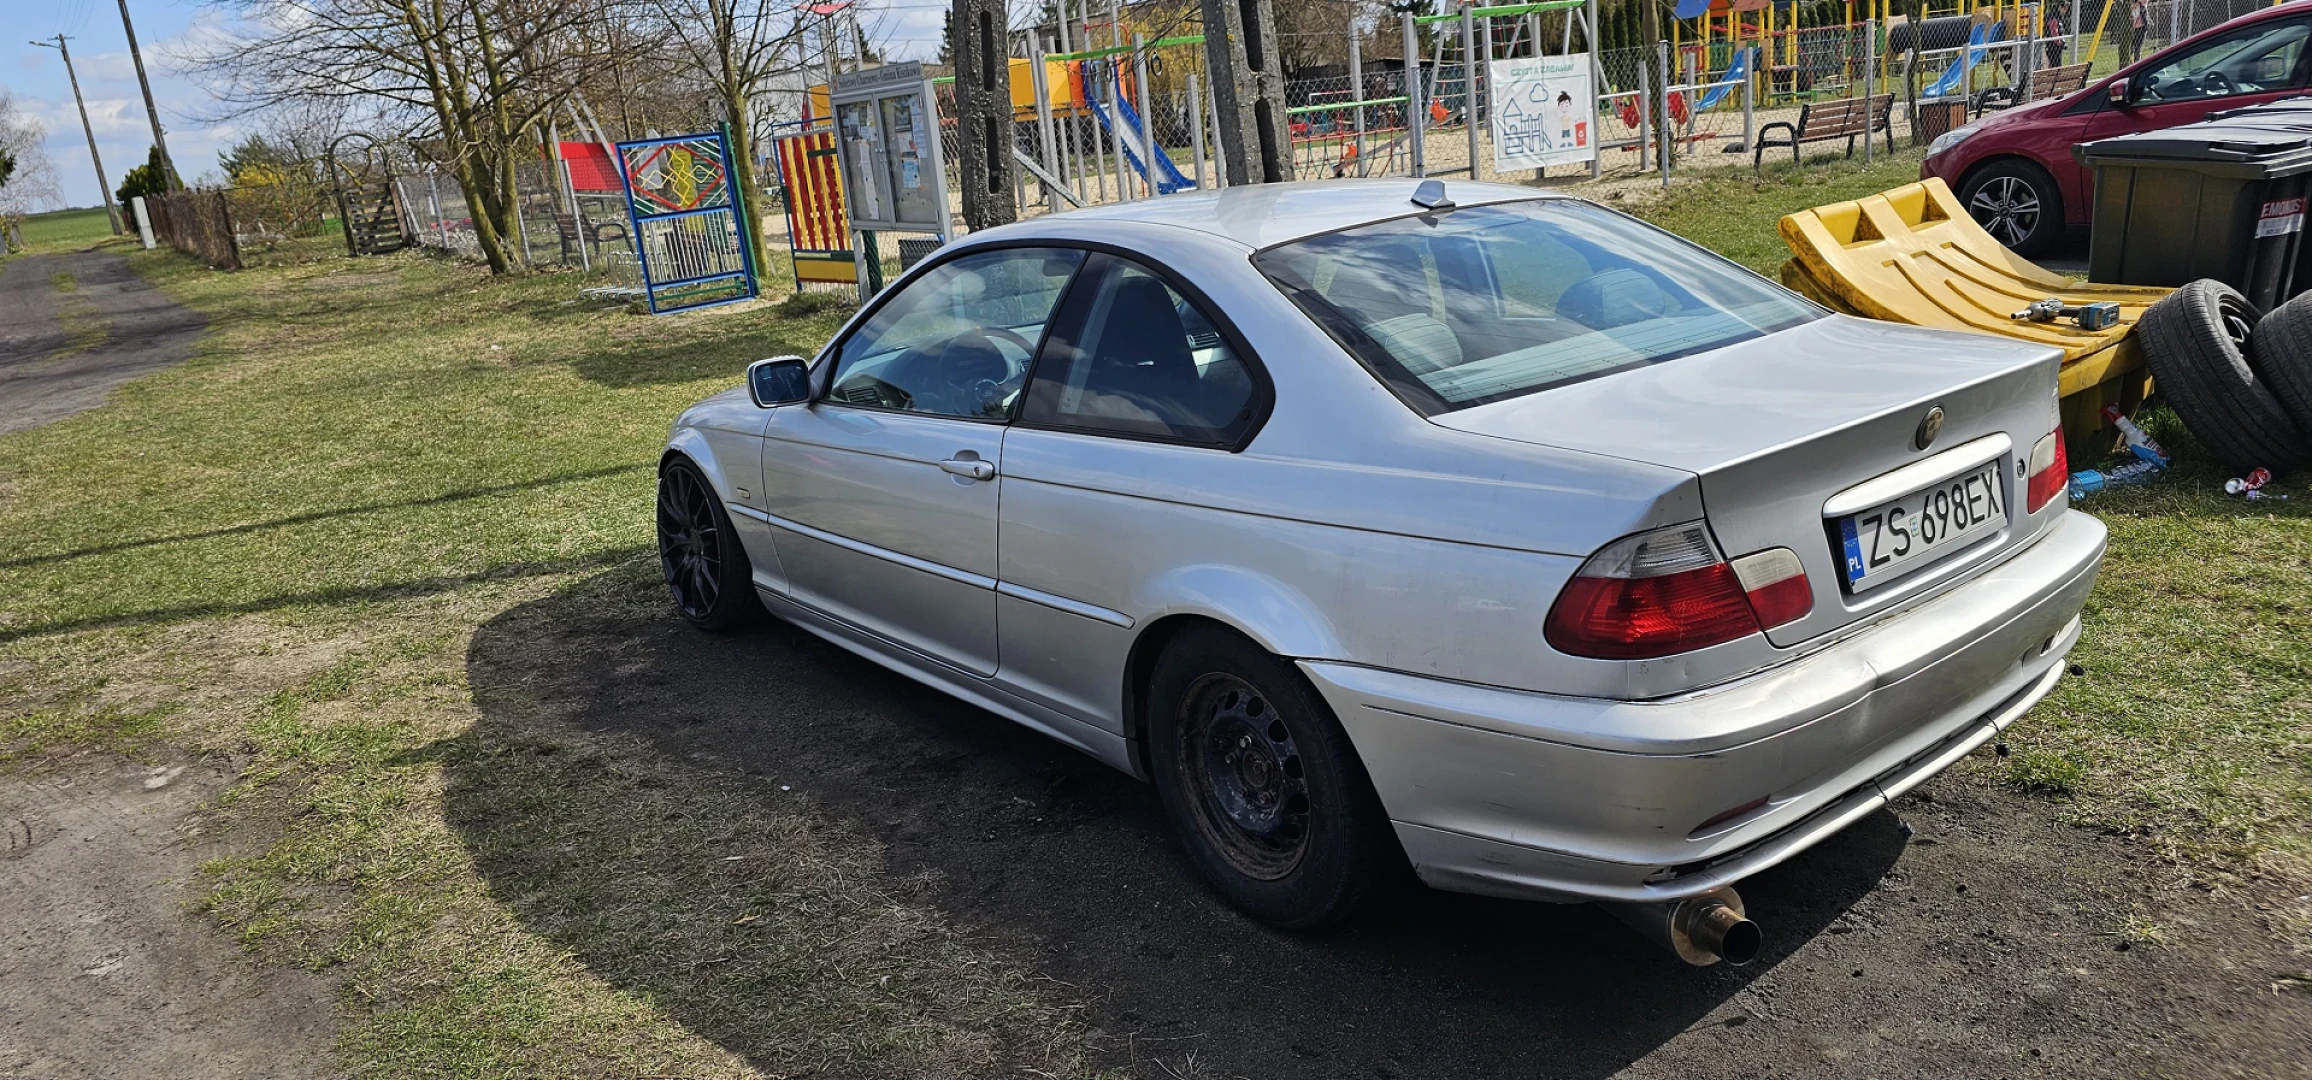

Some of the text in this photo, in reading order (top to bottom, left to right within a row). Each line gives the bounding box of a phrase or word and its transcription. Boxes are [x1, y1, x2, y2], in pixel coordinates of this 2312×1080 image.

[1511, 66, 1539, 77] CZYSTA
[1862, 465, 2000, 568] ZS 698EX
[1849, 557, 1862, 572] PL
